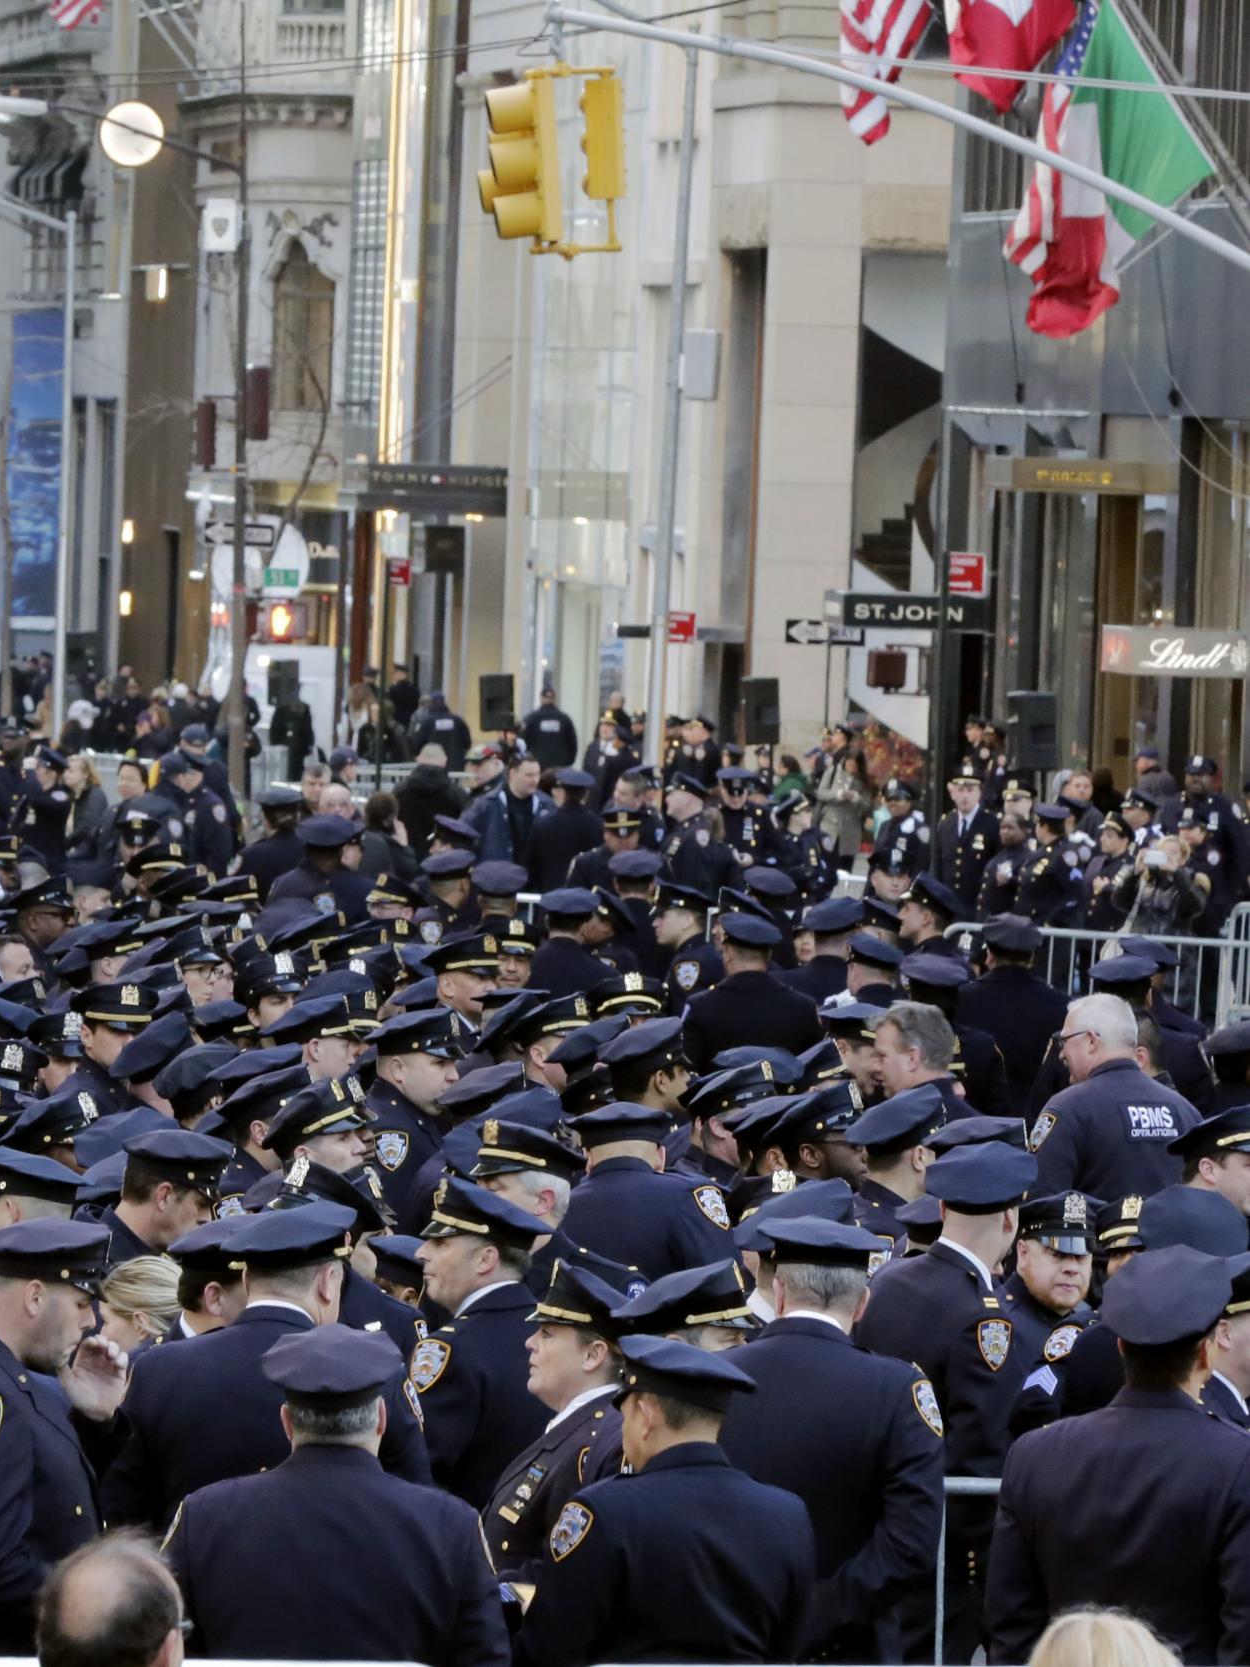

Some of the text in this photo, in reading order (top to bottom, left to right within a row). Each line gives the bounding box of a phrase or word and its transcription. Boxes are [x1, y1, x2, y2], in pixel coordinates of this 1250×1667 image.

[890, 604, 964, 622] JOHN
[1139, 637, 1230, 670] Lindt
[1127, 1106, 1174, 1128] PBMS
[1131, 1128, 1179, 1137] OPERATIONS
